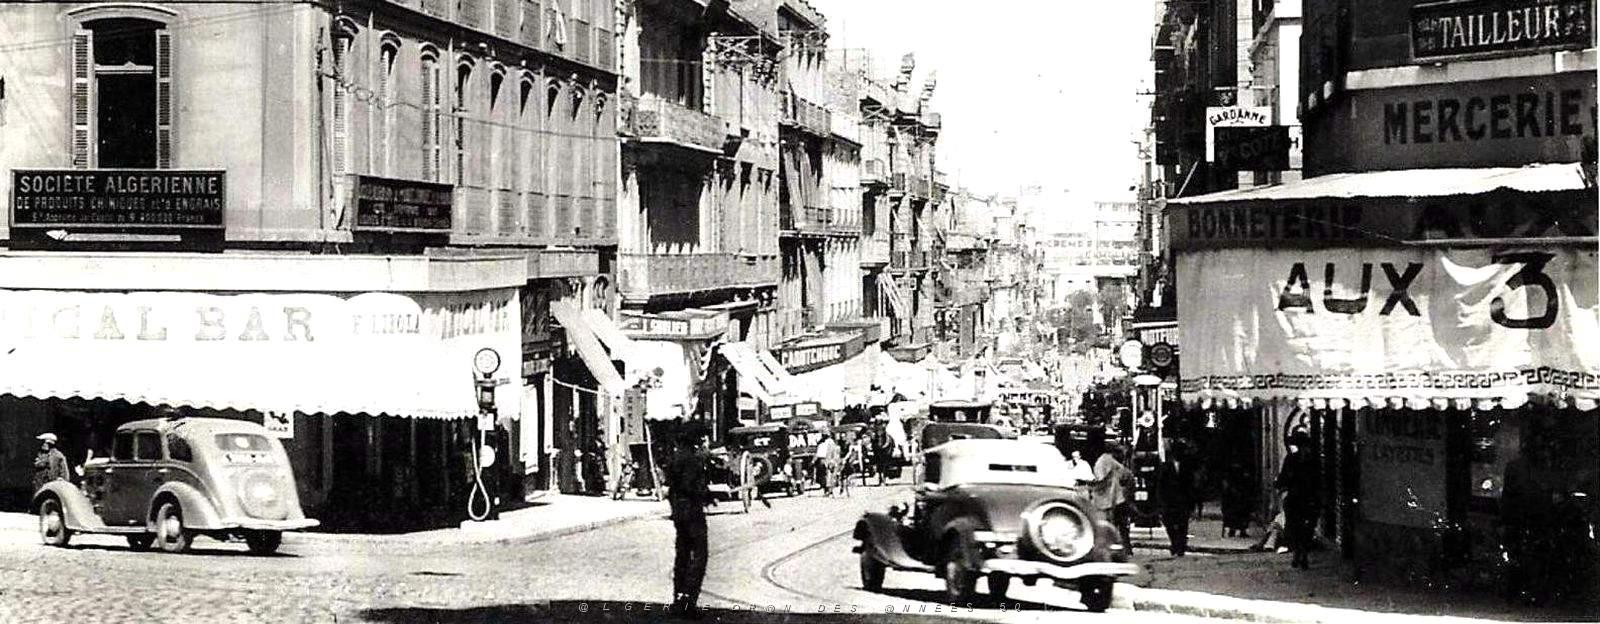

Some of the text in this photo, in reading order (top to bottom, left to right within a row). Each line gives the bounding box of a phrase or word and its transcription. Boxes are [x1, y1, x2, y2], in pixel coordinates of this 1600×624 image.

[1439, 5, 1560, 49] TAILLEUR
[1209, 108, 1268, 126] GARDANNE
[1383, 89, 1583, 145] MERCERIE
[16, 197, 30, 209] DE
[34, 197, 84, 209] PRODUITS
[1277, 252, 1559, 329] AUX 3
[194, 305, 315, 341] BAR
